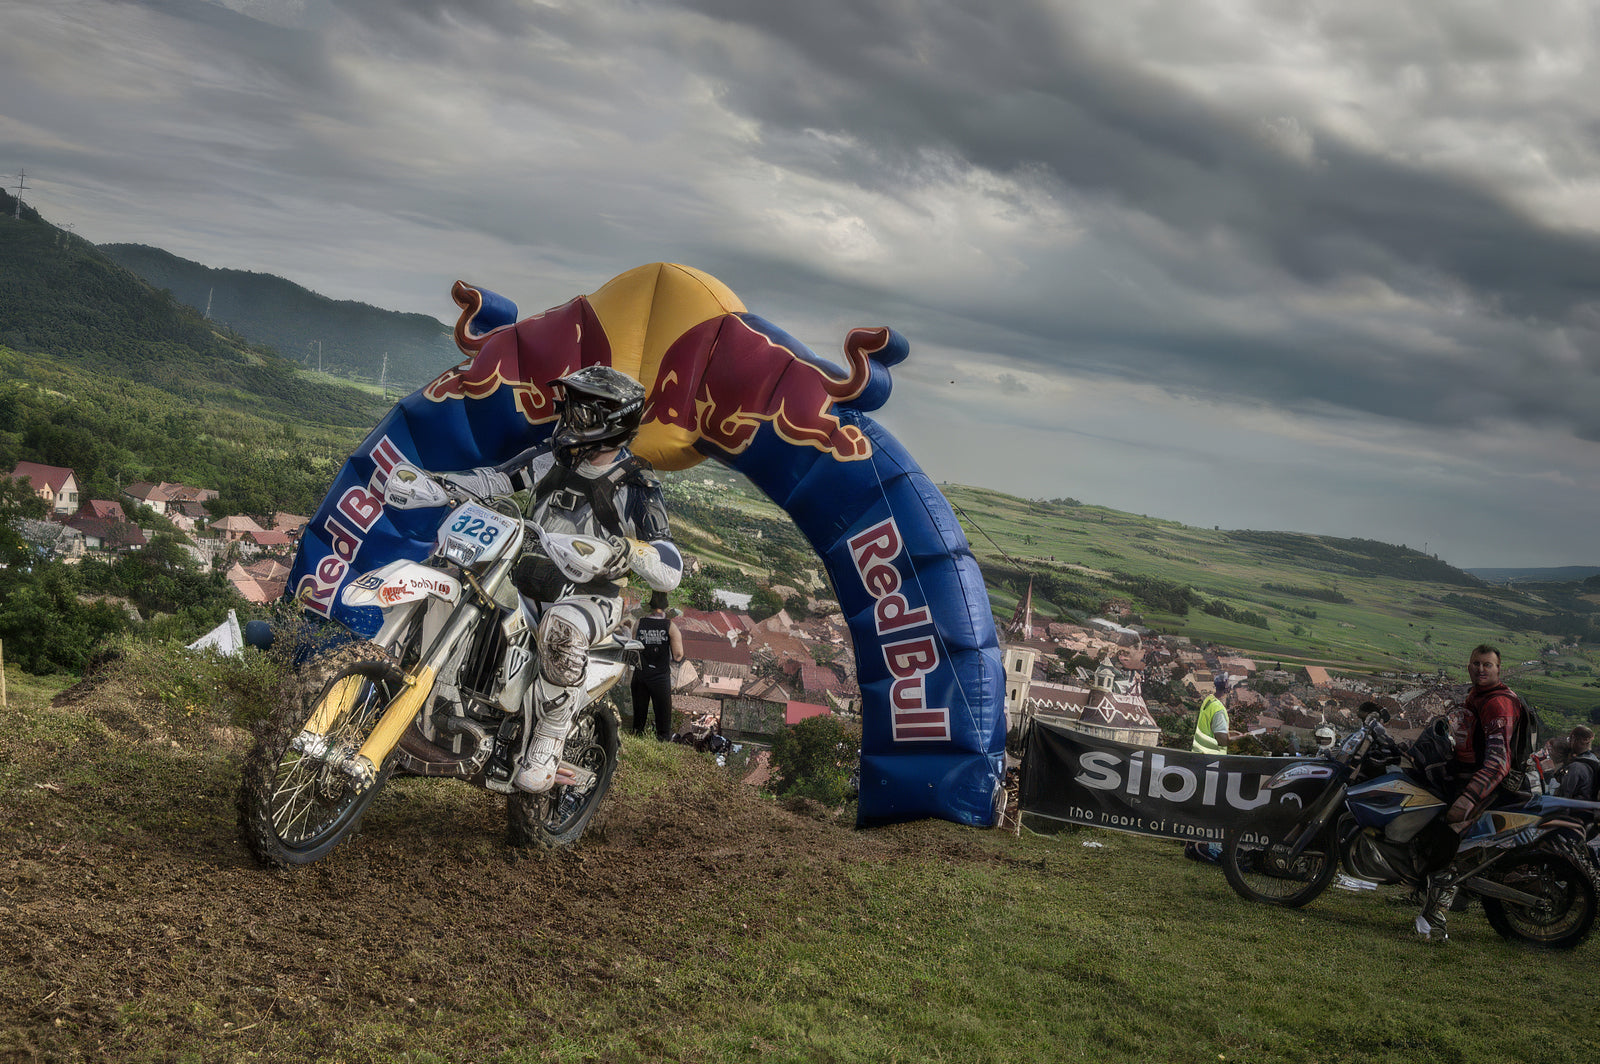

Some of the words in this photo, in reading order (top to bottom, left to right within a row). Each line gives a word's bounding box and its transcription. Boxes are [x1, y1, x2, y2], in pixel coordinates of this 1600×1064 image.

[296, 515, 363, 620] Red
[336, 434, 410, 534] Bull
[451, 514, 499, 547] 328
[847, 516, 933, 636] Red
[881, 634, 951, 741] Bull
[1074, 750, 1273, 811] sibiu
